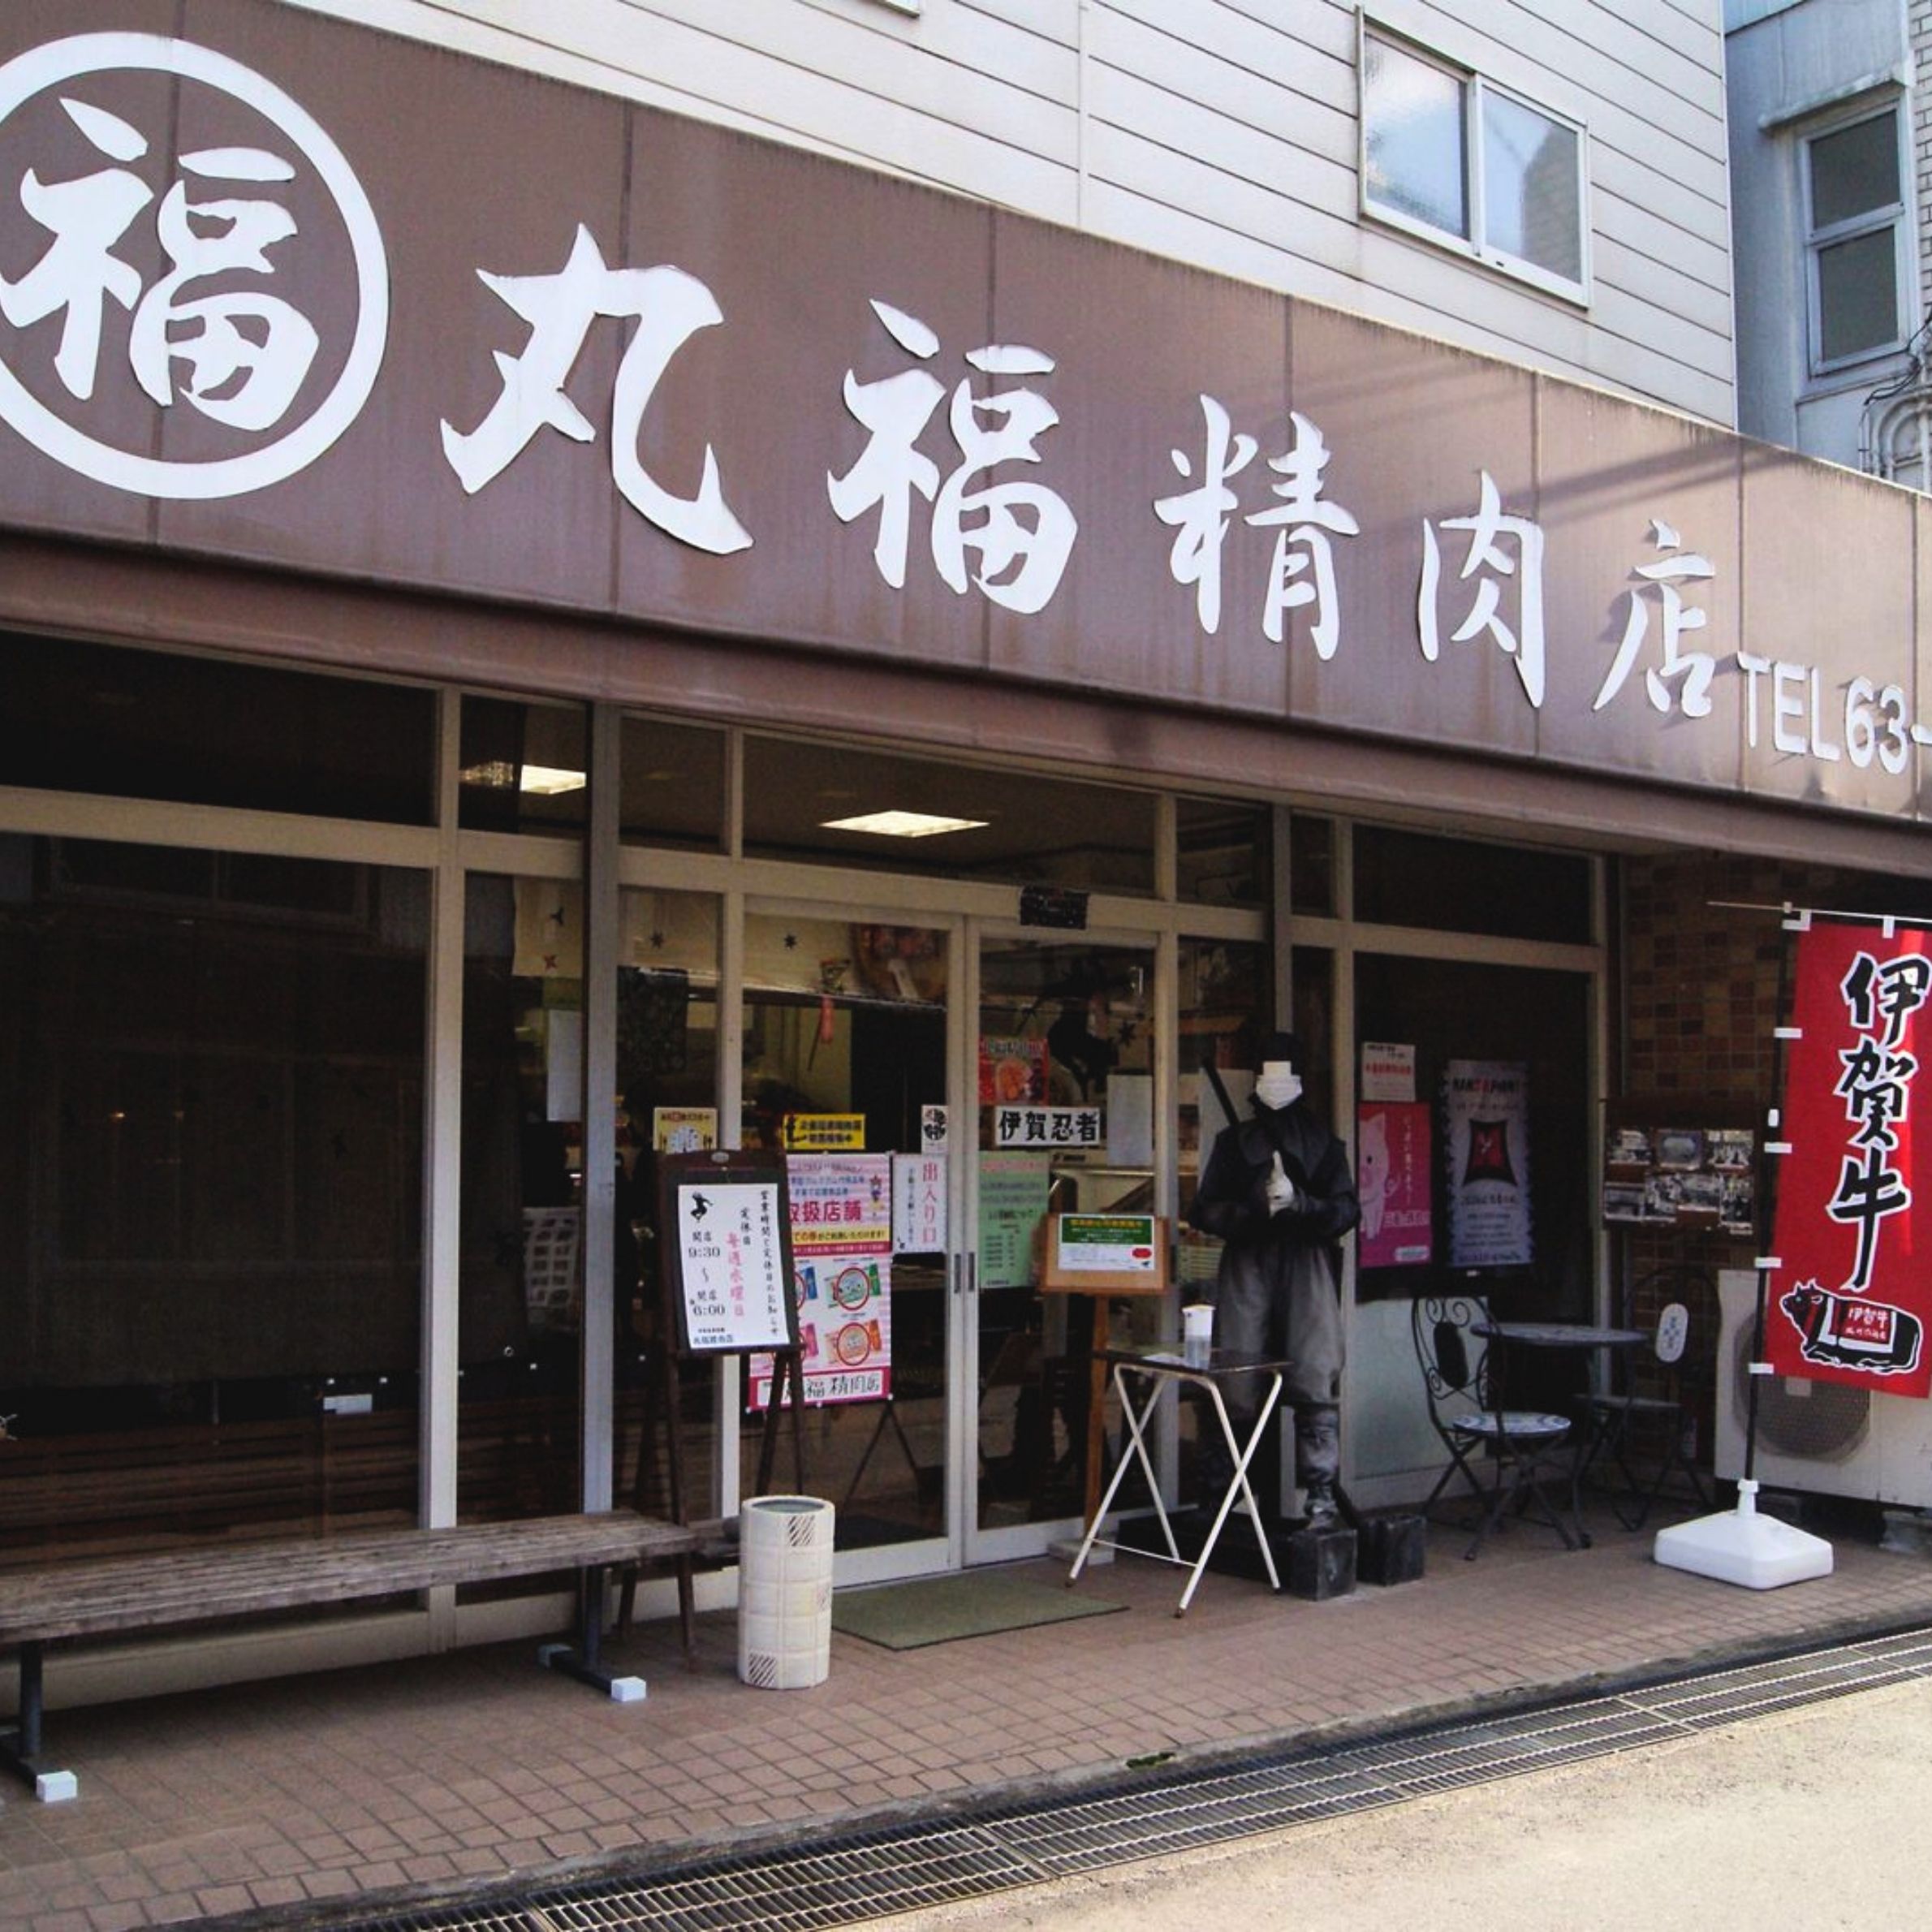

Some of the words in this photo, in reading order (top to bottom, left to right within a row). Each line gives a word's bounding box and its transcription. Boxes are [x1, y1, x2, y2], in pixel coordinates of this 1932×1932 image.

[0, 97, 320, 431] 福
[440, 222, 1715, 718] 丸福精肉店
[999, 1110, 1098, 1141] 伊賀忍者
[1828, 953, 1930, 1290] 伊賀牛
[688, 1246, 721, 1258] 9:30
[692, 1304, 726, 1317] 6:00
